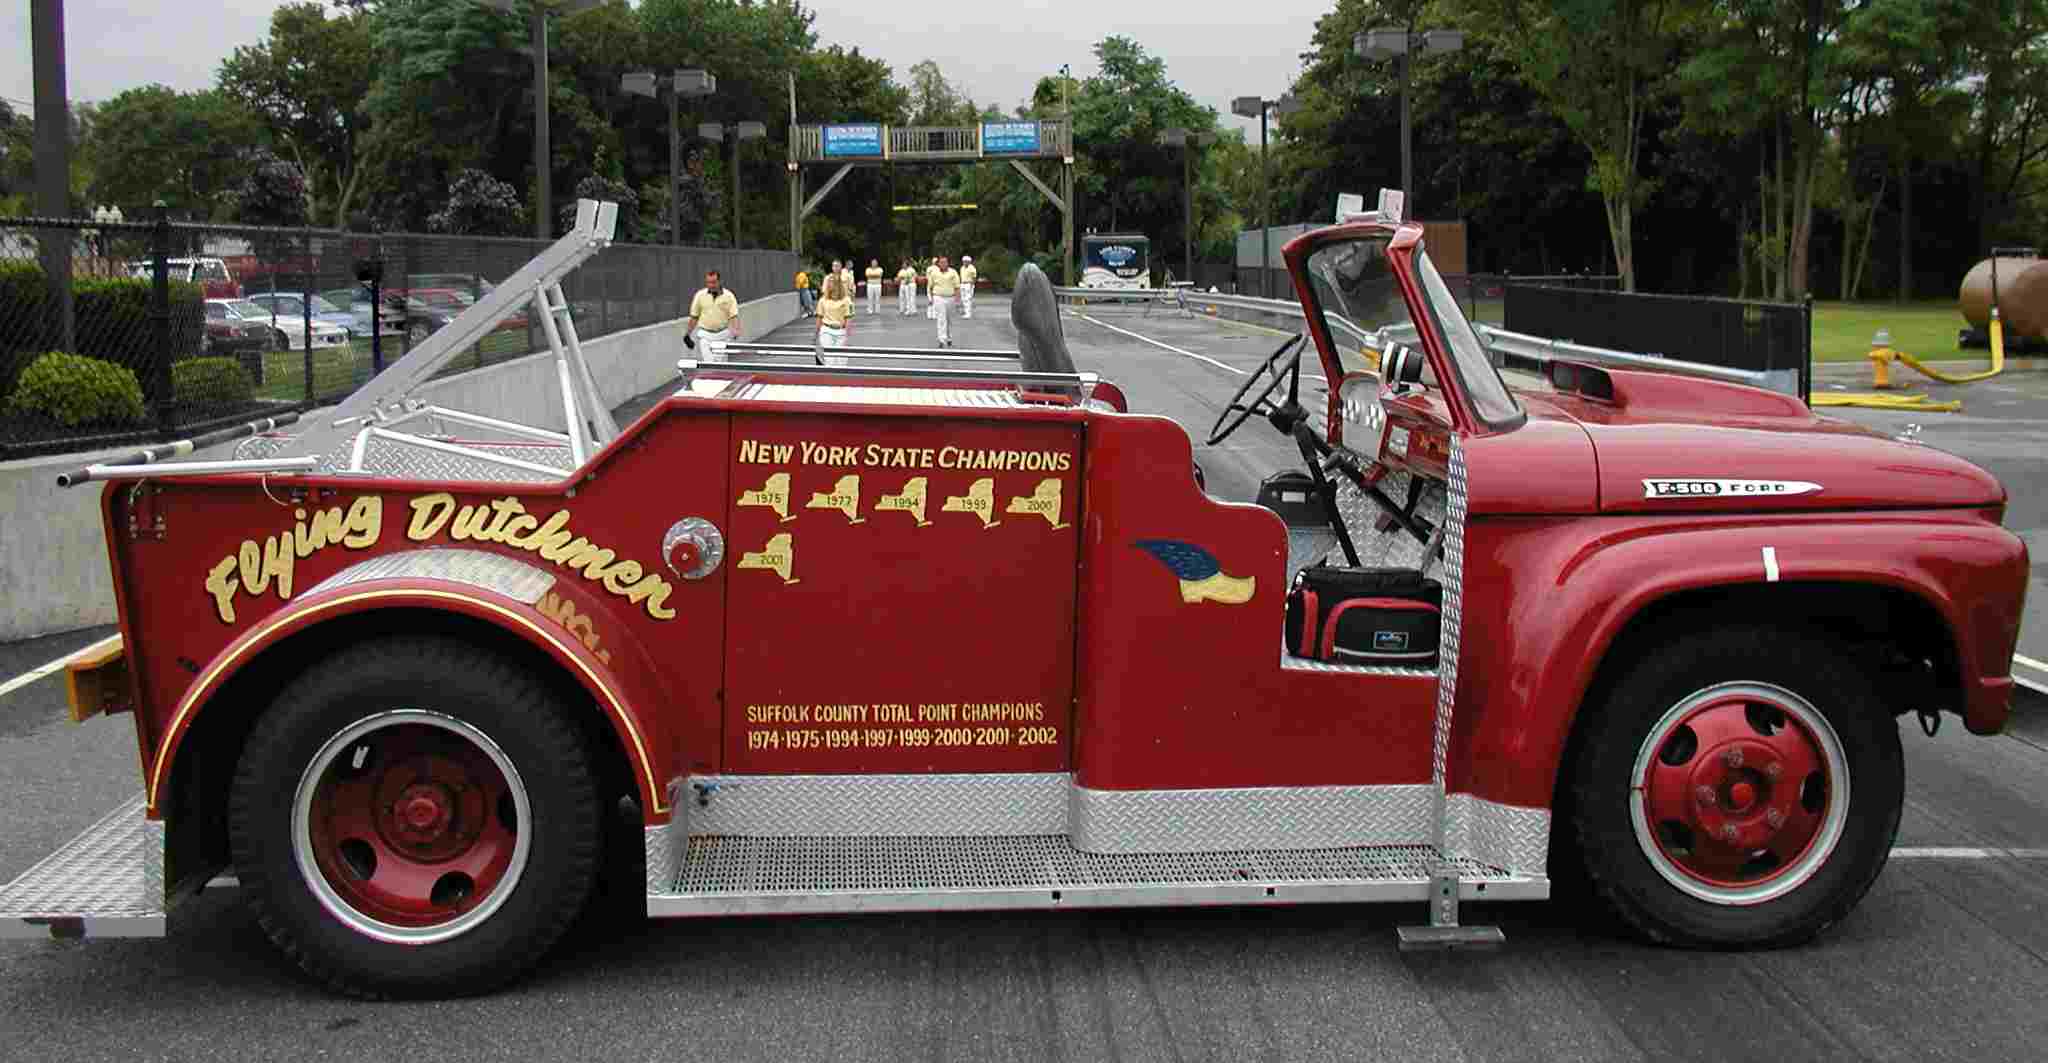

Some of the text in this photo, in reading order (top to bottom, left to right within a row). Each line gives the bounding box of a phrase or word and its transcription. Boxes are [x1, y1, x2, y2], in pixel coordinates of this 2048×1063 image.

[739, 440, 1072, 471] NEW YORK STATE CHAMPIONS
[1731, 484, 1785, 492] FORD
[756, 493, 782, 504] 1975
[827, 495, 852, 506] 1977
[893, 497, 919, 507] 1994
[961, 499, 987, 510] 1999
[205, 492, 676, 623] Flying Dutchmen
[760, 554, 783, 566] 2001
[747, 702, 1044, 722] SUFFOLK COUNTY TOTAL POINT CHAMPIONS
